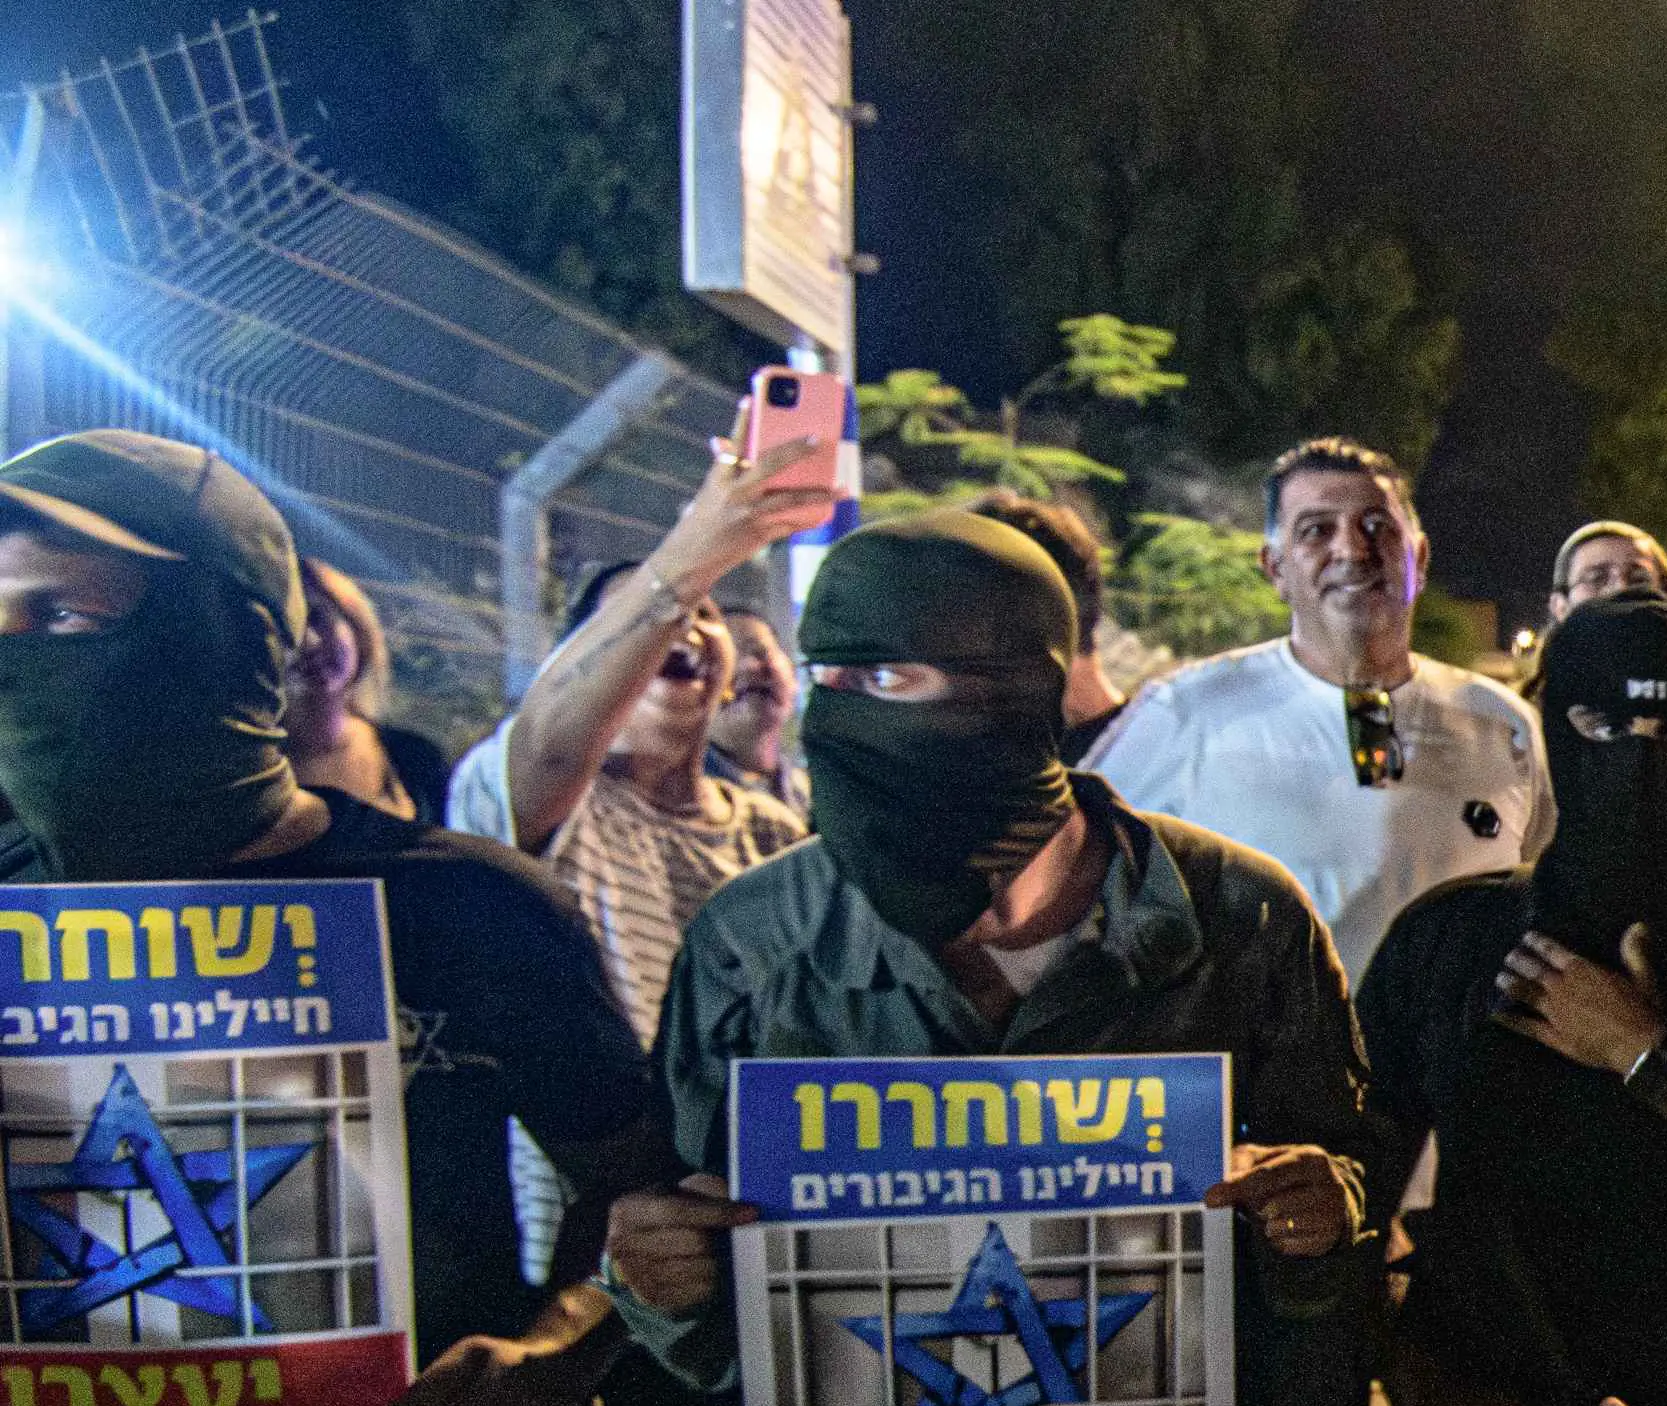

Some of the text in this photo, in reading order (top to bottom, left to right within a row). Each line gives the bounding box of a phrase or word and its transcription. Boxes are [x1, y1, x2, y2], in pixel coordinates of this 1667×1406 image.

[0, 988, 332, 1045] חיילינו הגיב
[790, 1156, 1174, 1210] חיילינו הגיבורים
